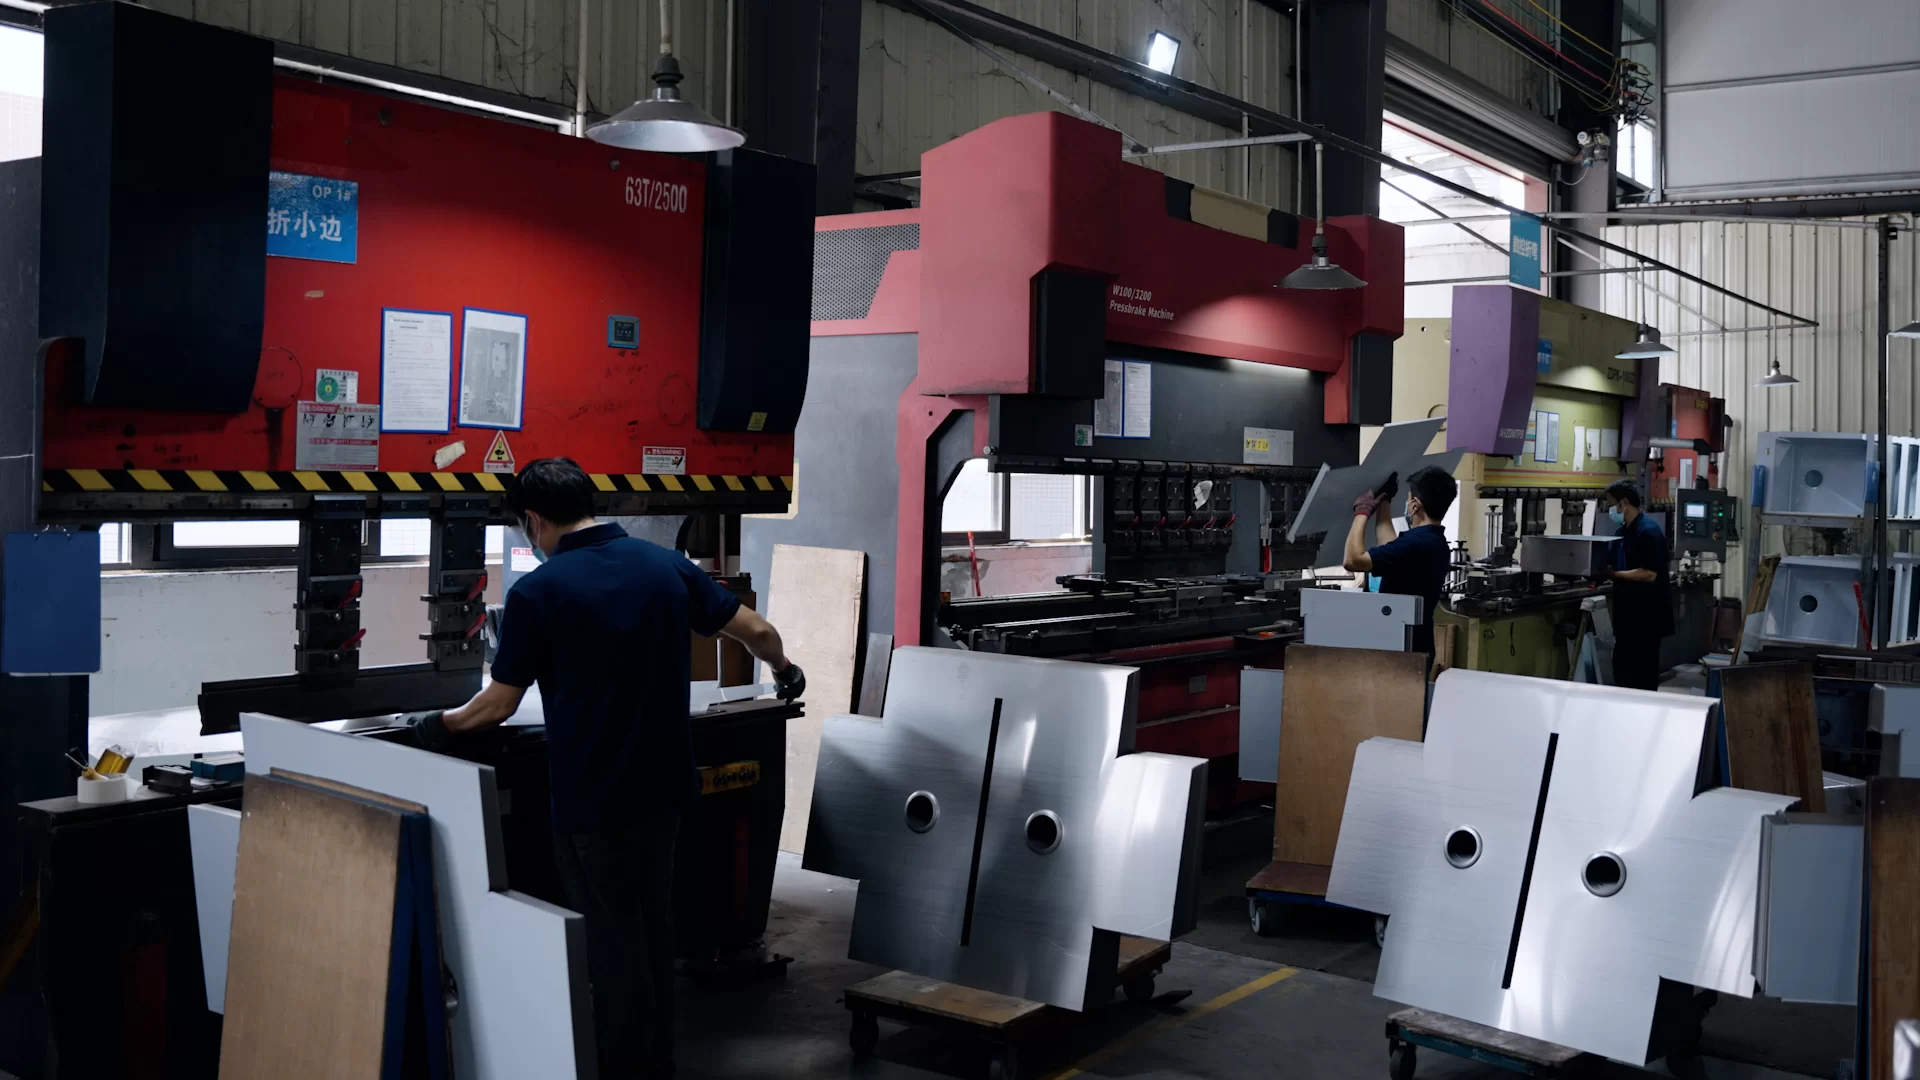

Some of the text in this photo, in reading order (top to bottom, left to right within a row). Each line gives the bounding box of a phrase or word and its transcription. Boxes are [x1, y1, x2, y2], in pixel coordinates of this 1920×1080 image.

[312, 185, 352, 201] OP 1#
[625, 176, 688, 213] 63T/2500
[267, 207, 343, 242] 折小边
[1112, 284, 1152, 301] W100/3200
[1109, 300, 1174, 320] Pressbrake Machine
